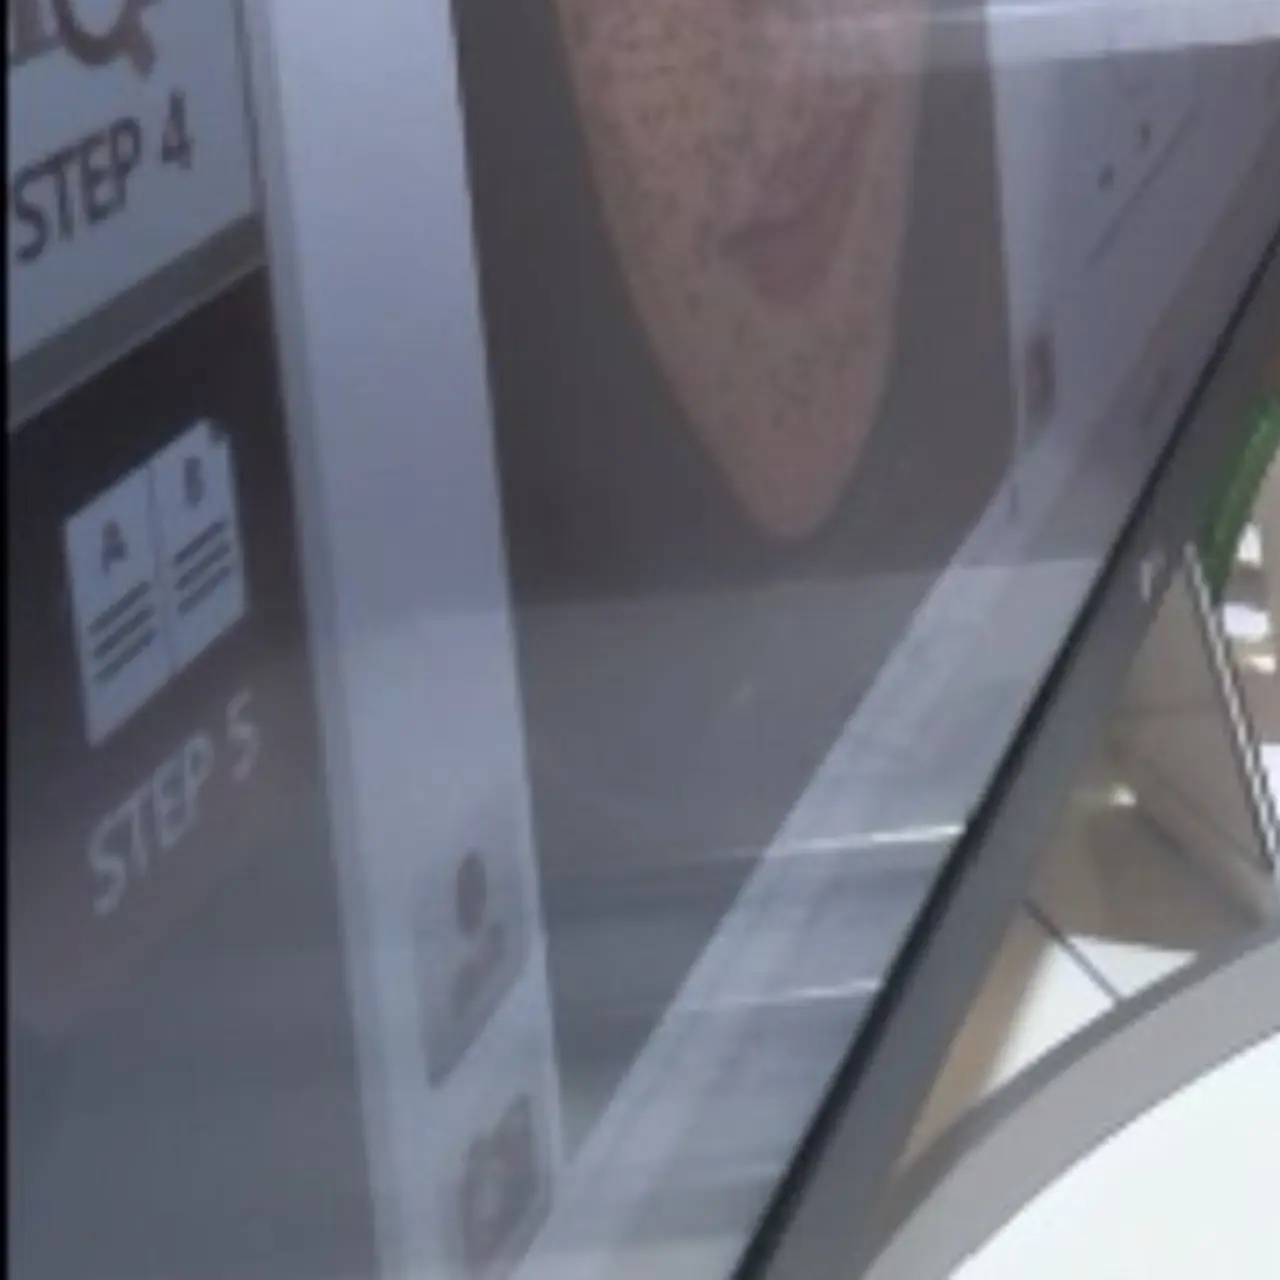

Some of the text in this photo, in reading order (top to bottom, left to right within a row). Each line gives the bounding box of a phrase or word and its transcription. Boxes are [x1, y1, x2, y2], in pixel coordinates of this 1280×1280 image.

[13, 90, 195, 266] STEP 4
[88, 687, 261, 915] STEP 5
